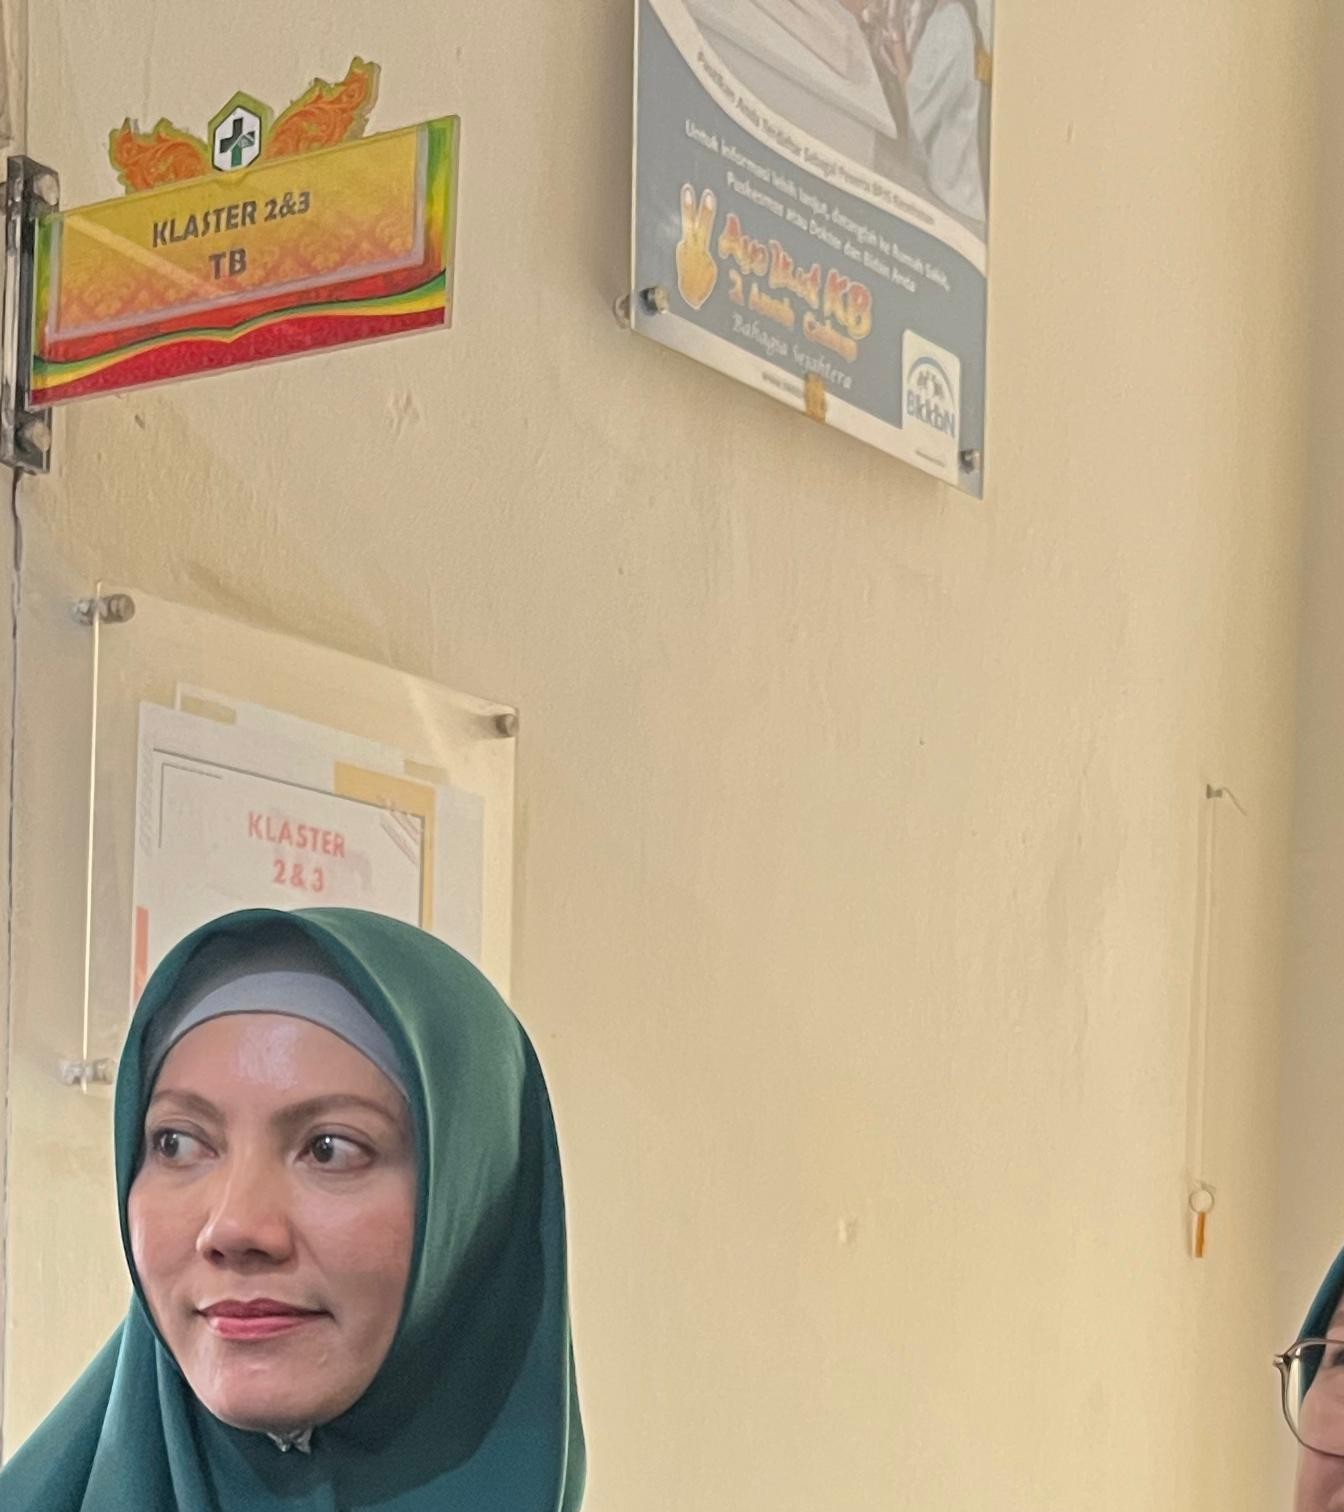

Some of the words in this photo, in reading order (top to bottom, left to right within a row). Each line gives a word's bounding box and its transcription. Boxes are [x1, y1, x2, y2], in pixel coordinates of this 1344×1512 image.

[152, 199, 256, 248] KLASTER
[264, 190, 311, 224] 2&3
[209, 248, 247, 281] TB
[824, 268, 872, 340] KB
[247, 811, 346, 860] KLASTER
